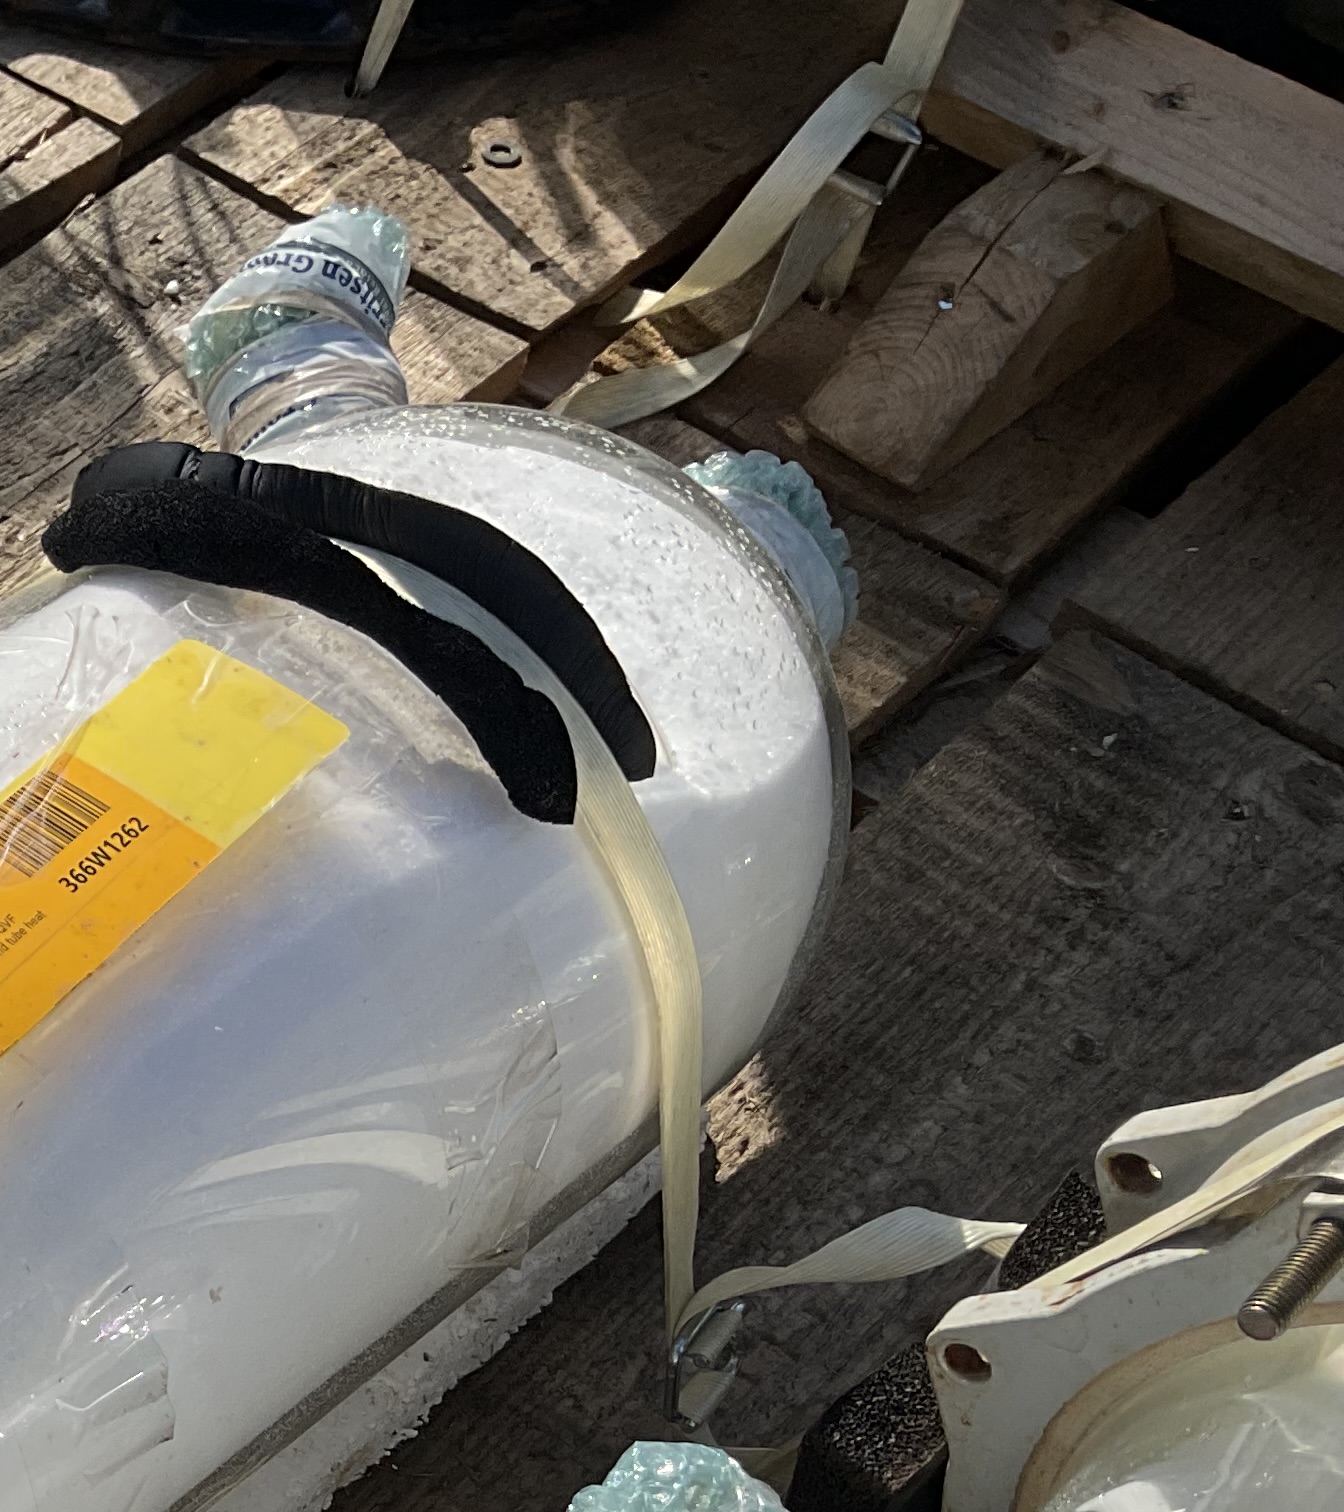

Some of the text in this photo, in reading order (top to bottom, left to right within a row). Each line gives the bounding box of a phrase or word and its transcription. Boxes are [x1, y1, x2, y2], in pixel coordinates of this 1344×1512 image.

[58, 816, 150, 893] 366W1262
[5, 926, 28, 946] tube
[24, 910, 47, 930] heat
